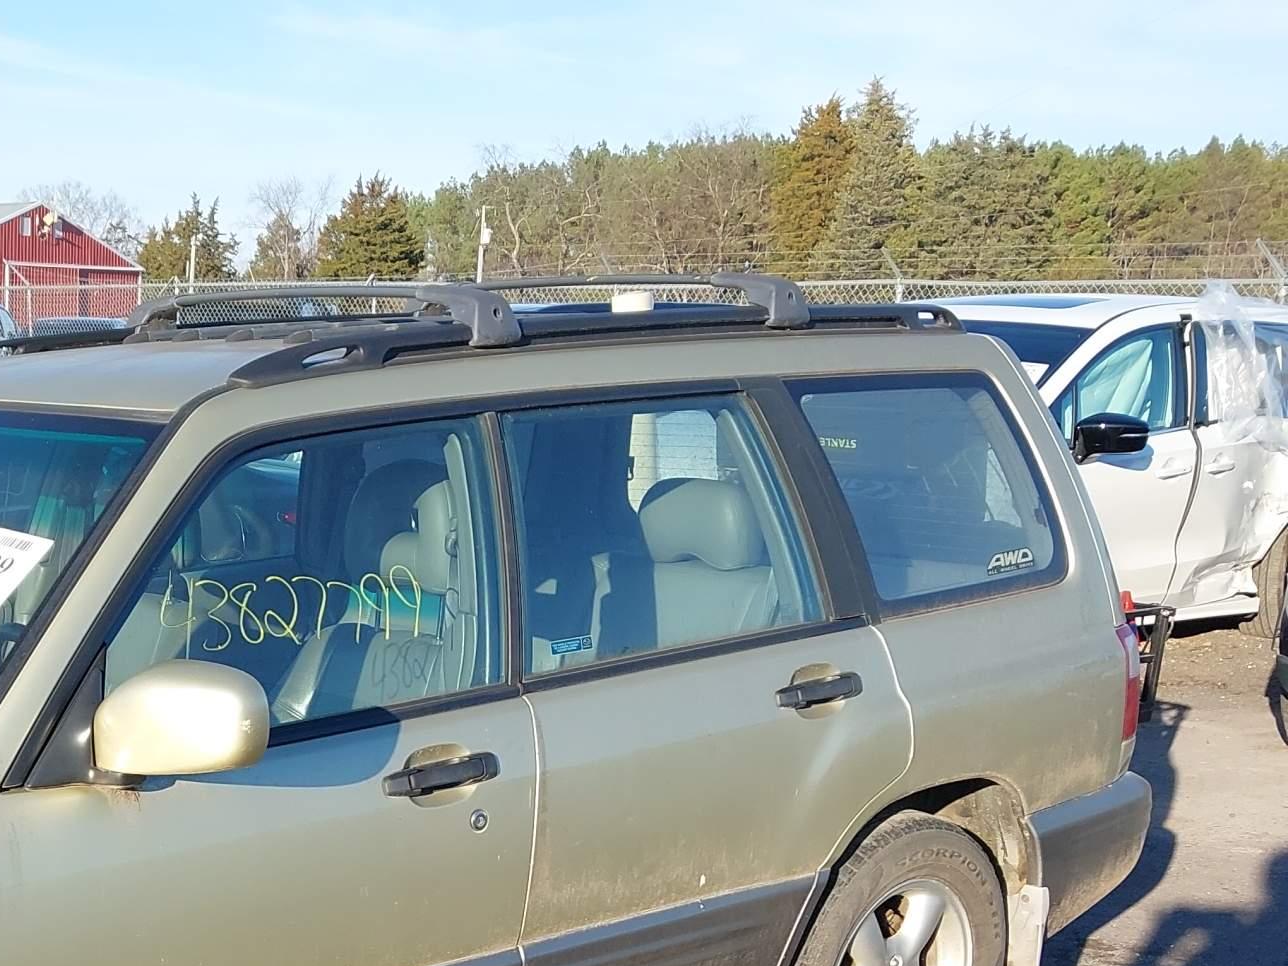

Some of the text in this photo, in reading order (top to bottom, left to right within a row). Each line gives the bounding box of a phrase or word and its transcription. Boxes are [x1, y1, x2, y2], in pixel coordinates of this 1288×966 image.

[819, 437, 857, 449] STANLE
[987, 548, 1033, 570] AWD
[161, 565, 421, 660] 43827799
